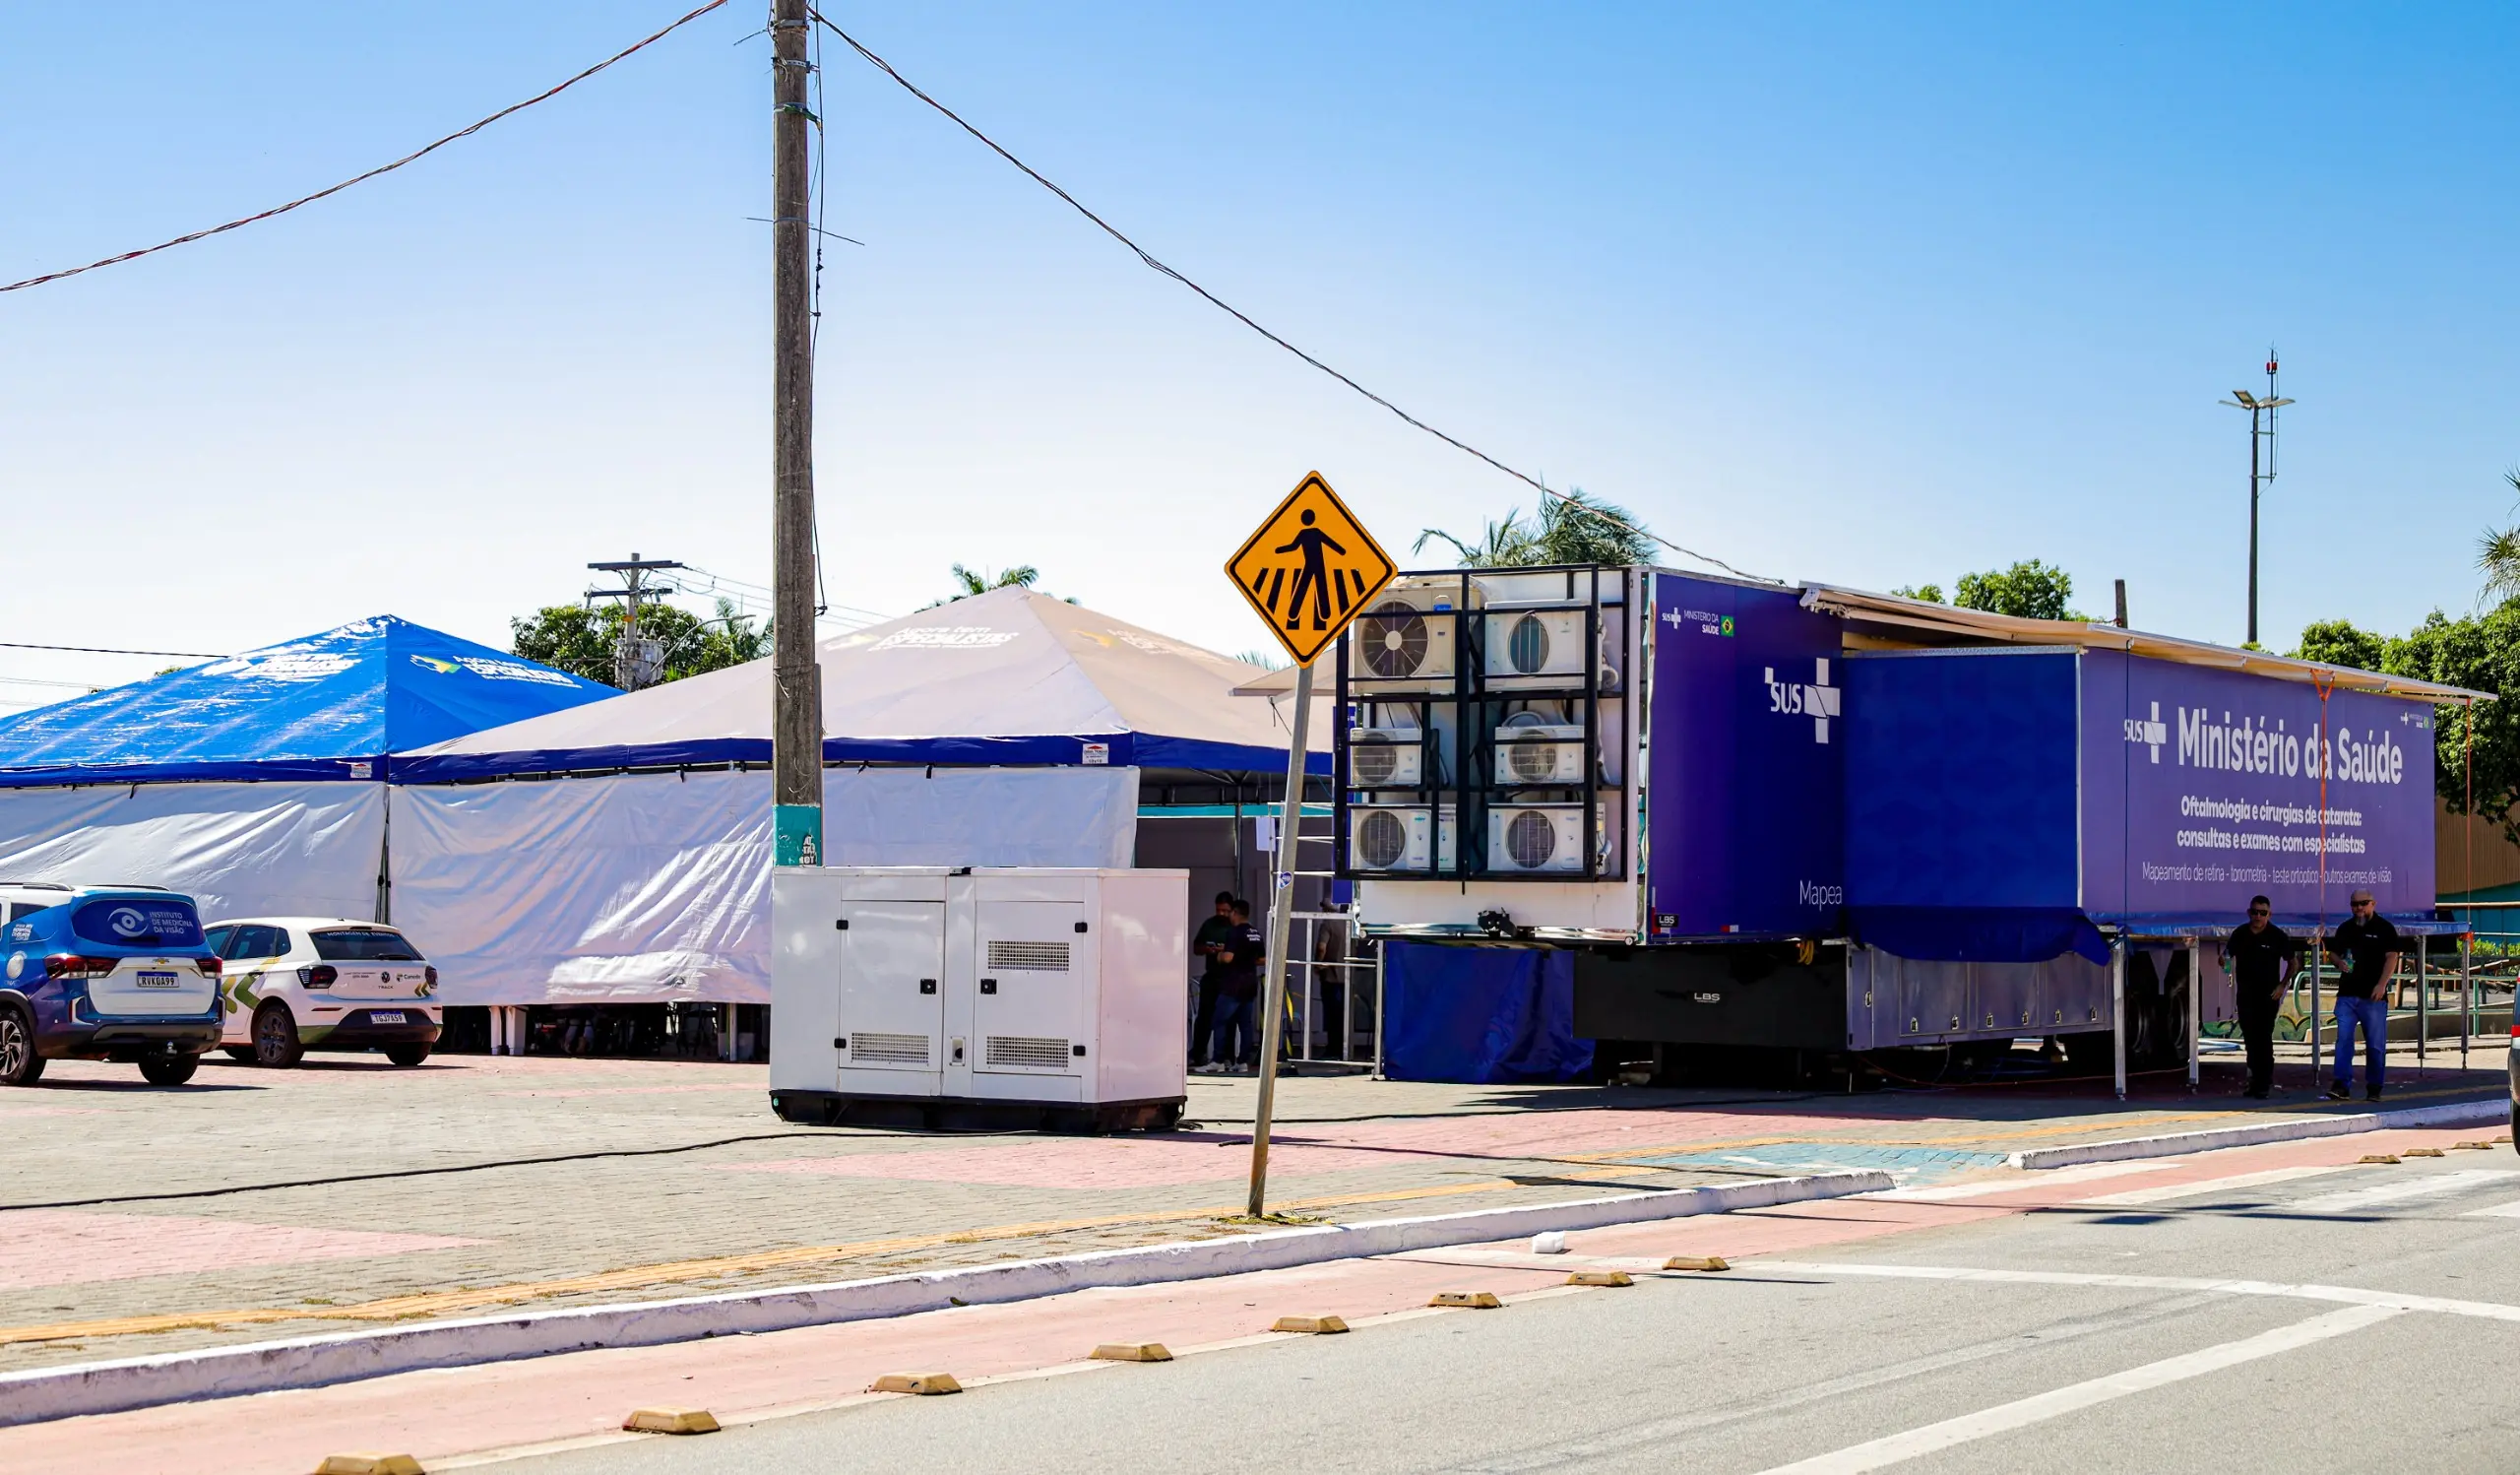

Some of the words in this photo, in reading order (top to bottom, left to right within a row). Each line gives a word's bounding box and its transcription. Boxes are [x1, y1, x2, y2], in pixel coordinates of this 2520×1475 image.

[1662, 612, 1670, 621] SUS
[1712, 613, 1719, 623] DA
[1702, 622, 1720, 635] SAÚDE
[1771, 682, 1801, 714] SUS
[2124, 719, 2143, 742] SUS
[2178, 707, 2299, 777] Ministério
[2304, 724, 2332, 780] da
[2338, 728, 2402, 784] Saúde
[2181, 795, 2250, 823] Oftalmologia
[2251, 805, 2258, 820] e
[2259, 800, 2303, 827] cirurgias
[2304, 805, 2316, 824] de
[2176, 827, 2231, 849] consultas
[2233, 834, 2238, 849] e
[2240, 833, 2281, 852] exames
[2282, 837, 2302, 853] com
[2142, 862, 2191, 885] Mapeamento
[2193, 864, 2203, 881] de
[2204, 864, 2225, 881] retina
[2231, 865, 2266, 883] tonometria
[2273, 866, 2289, 883] teste
[2324, 868, 2344, 884] outros
[2344, 870, 2367, 884] exames
[2368, 868, 2376, 884] de
[2377, 866, 2391, 883] visão
[1799, 879, 1842, 912] Mapea
[1694, 993, 1720, 1001] LBS
